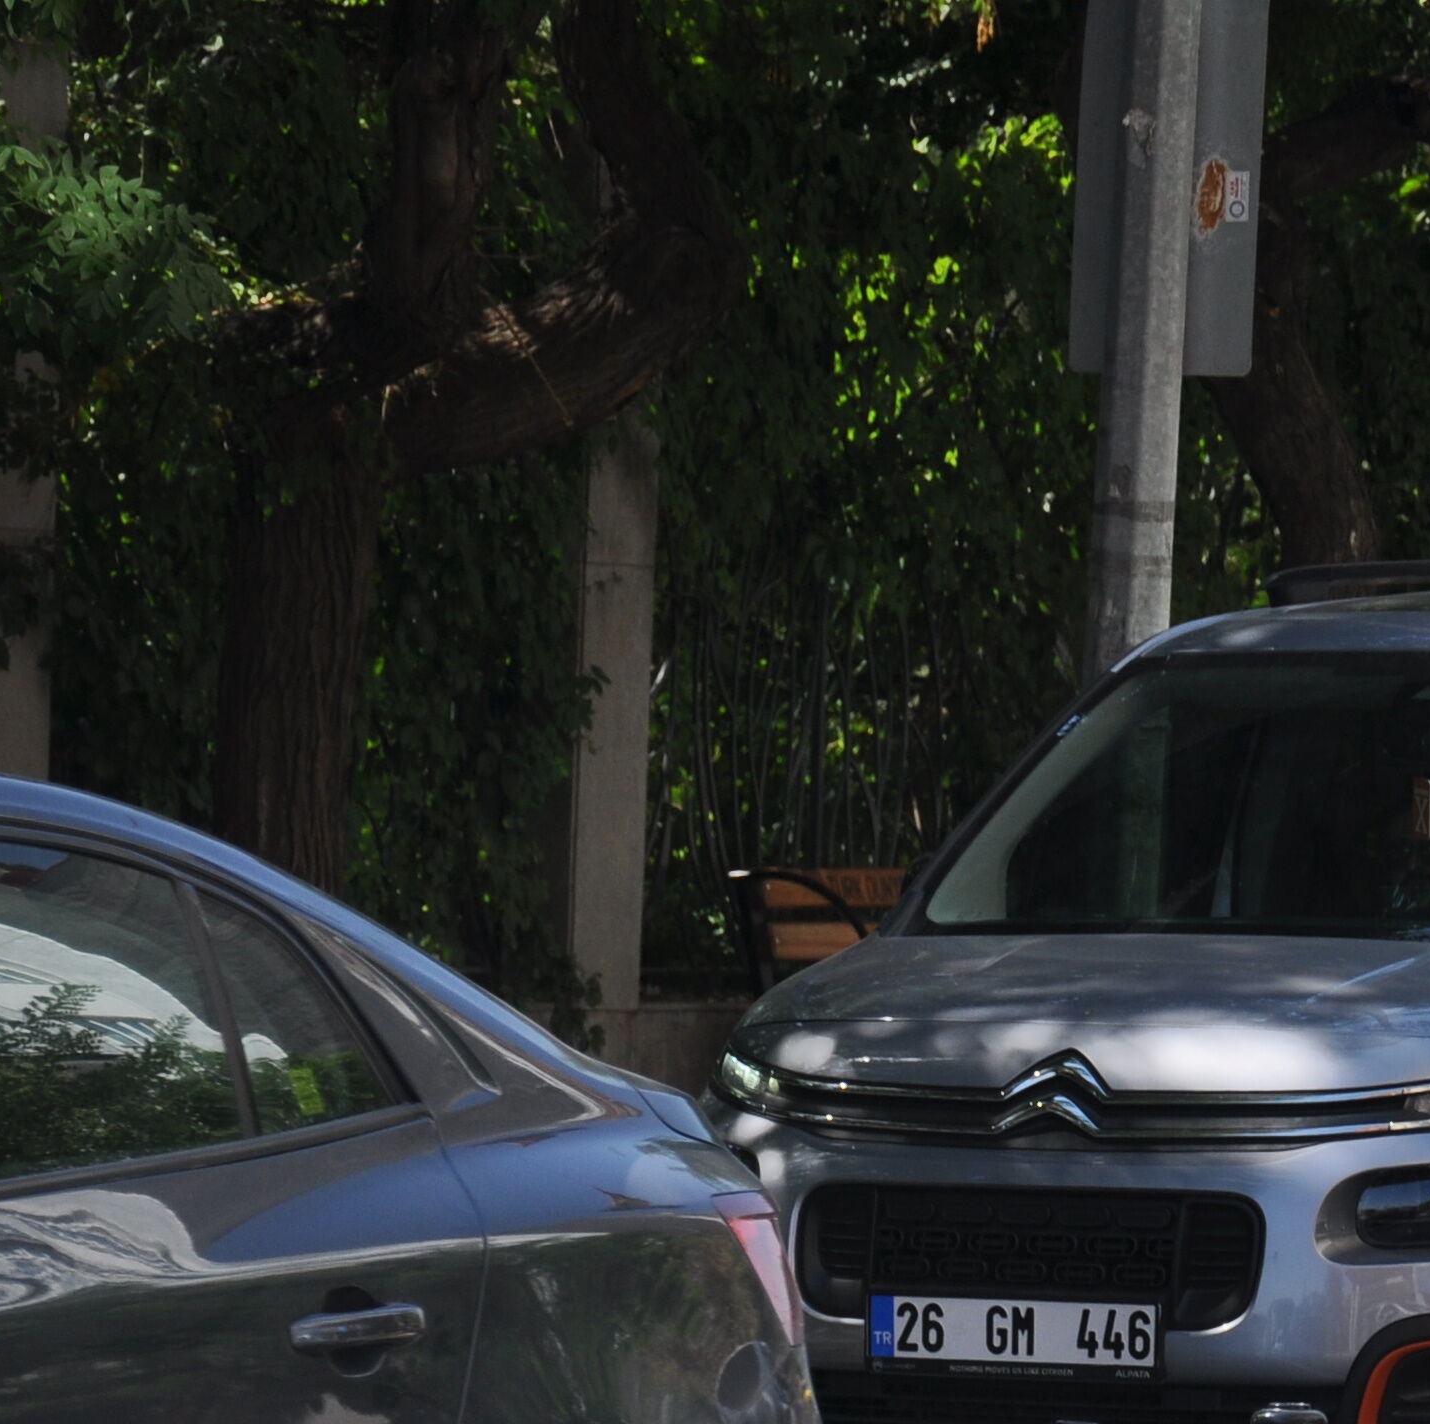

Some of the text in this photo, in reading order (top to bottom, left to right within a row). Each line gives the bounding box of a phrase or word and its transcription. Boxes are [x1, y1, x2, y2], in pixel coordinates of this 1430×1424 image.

[874, 1302, 1151, 1360] TR 26 GM 446
